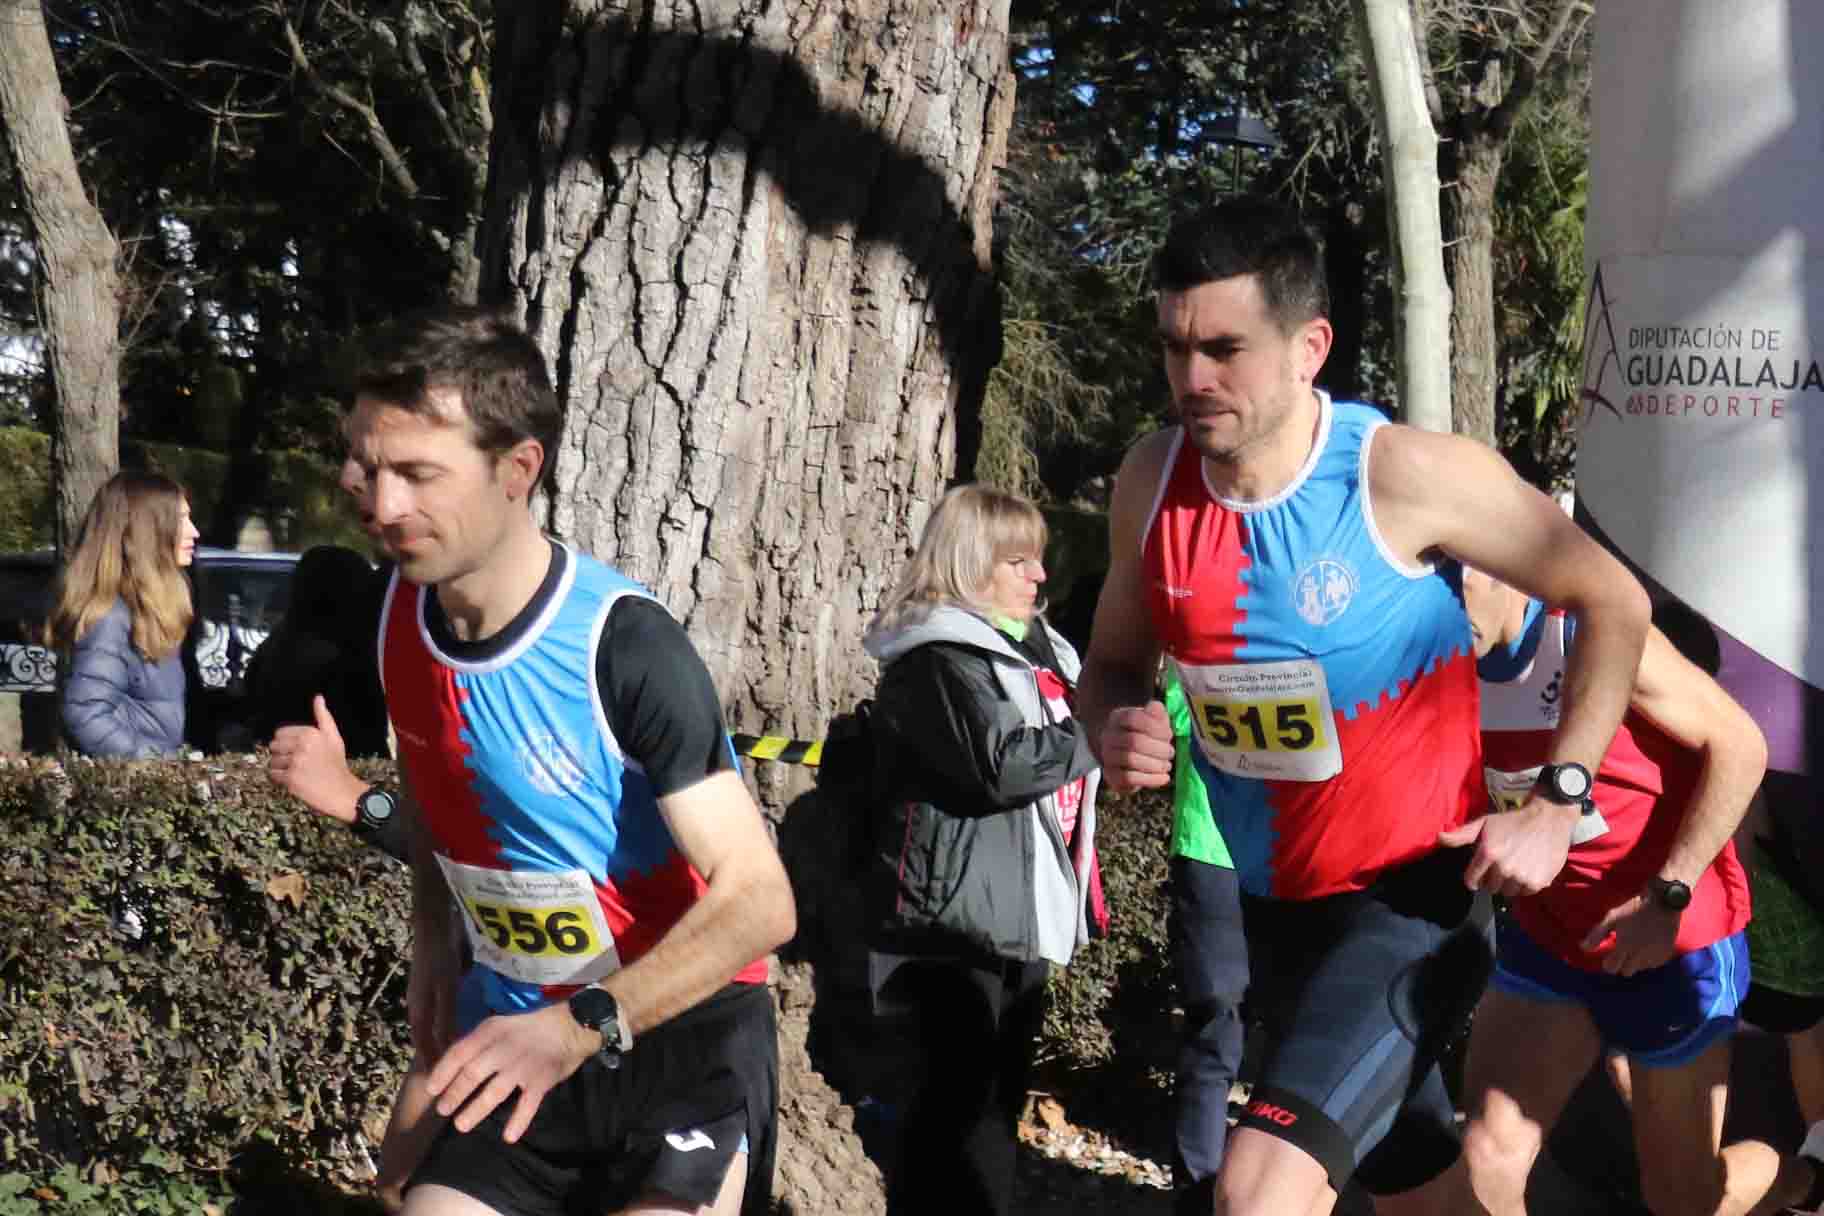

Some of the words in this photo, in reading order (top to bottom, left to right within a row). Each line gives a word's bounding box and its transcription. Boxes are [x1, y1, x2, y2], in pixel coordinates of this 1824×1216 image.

[1629, 323, 1742, 350] DIPUTACIÓN
[1751, 329, 1781, 350] DE
[1203, 703, 1315, 750] 515
[474, 903, 590, 954] 556
